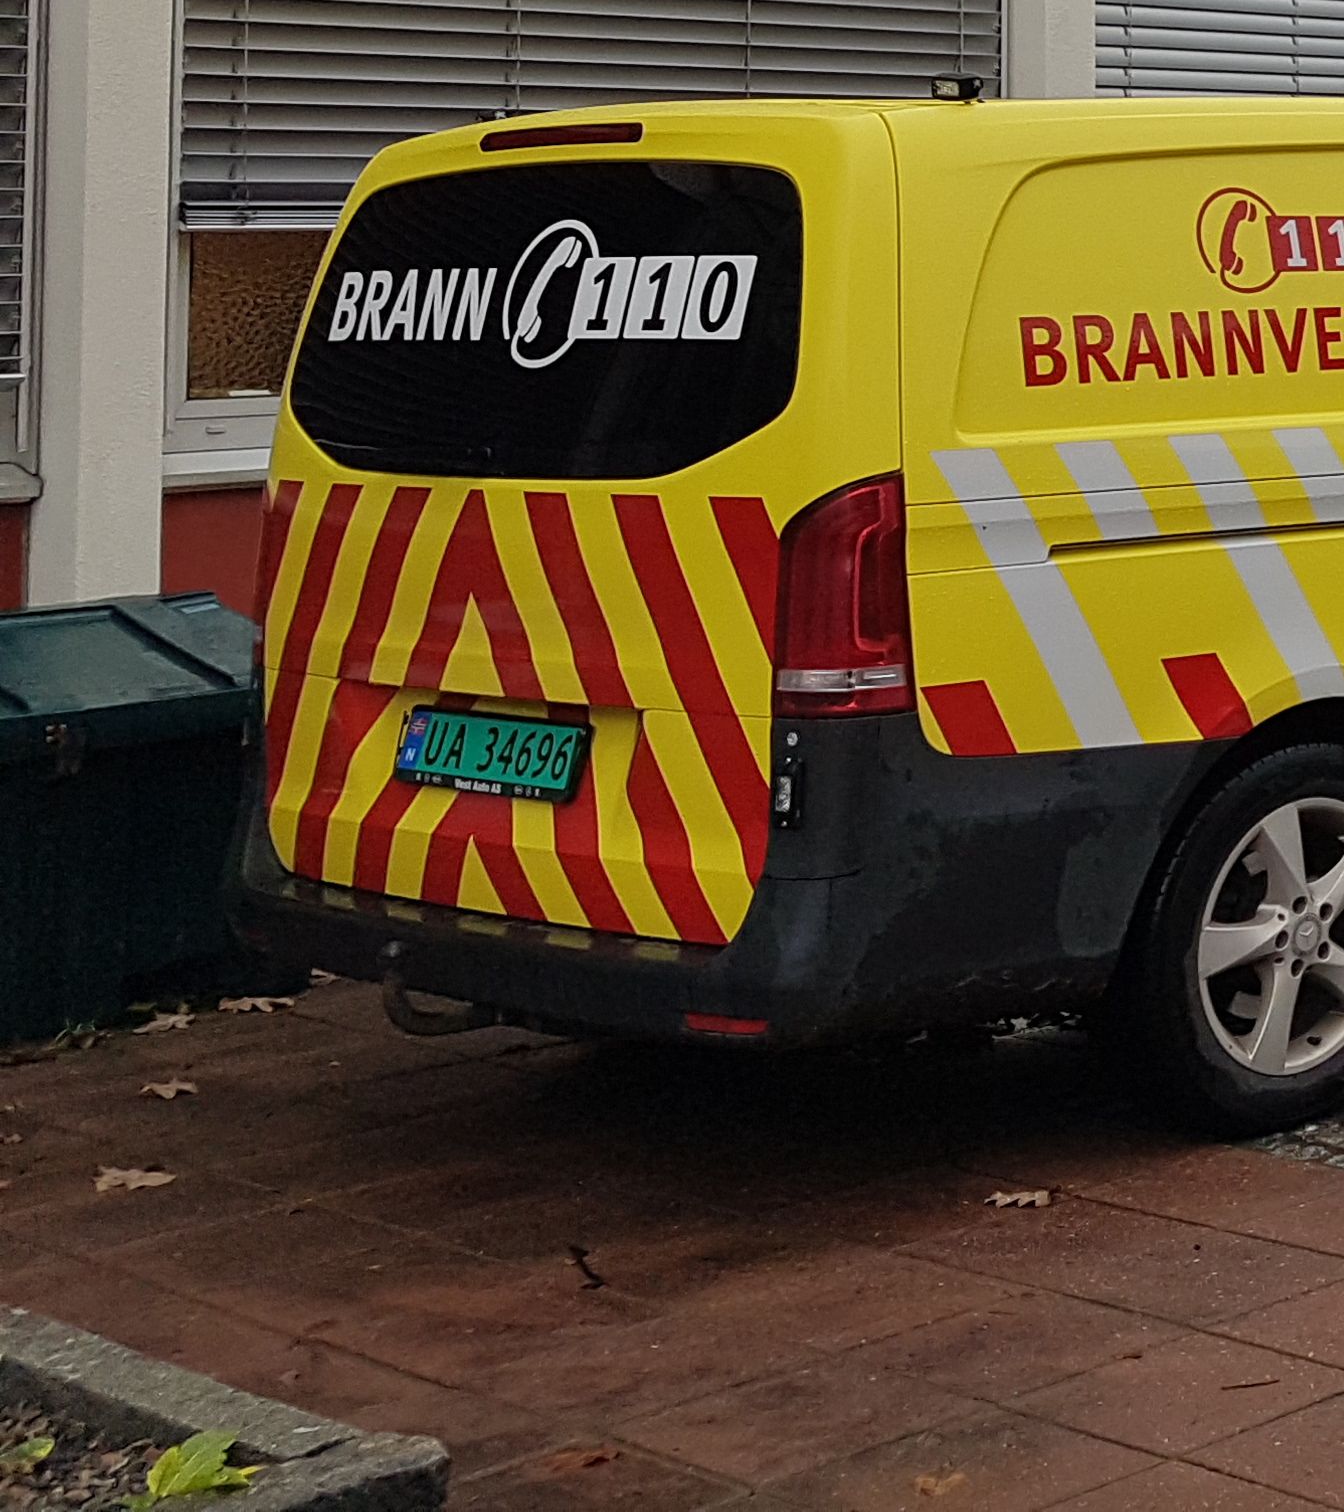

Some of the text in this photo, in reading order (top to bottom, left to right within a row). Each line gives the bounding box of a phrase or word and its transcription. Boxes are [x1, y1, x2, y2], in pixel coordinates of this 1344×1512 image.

[328, 260, 739, 341] BRANN 110
[404, 747, 417, 762] N
[424, 719, 574, 781] UA 34696
[491, 783, 502, 794] AS
